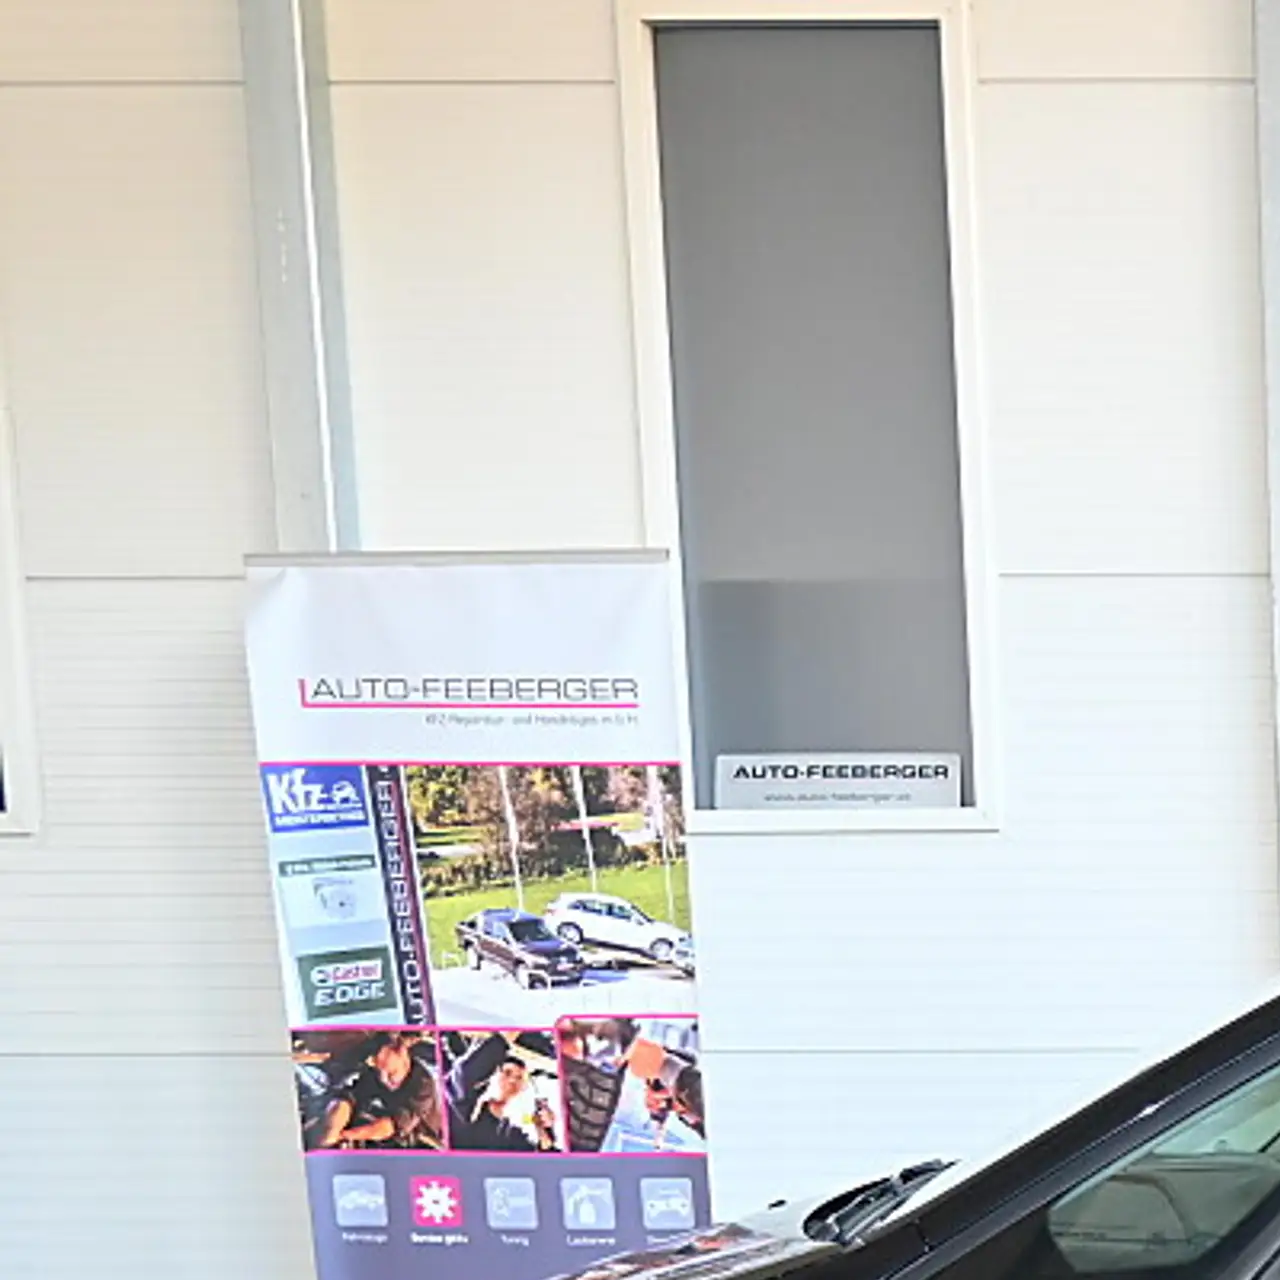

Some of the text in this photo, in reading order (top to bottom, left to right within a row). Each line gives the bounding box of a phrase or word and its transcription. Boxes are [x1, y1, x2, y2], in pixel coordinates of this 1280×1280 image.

[312, 678, 639, 700] AUTO-FEEBERGER
[733, 764, 949, 779] AUTO-FEEBERGER
[314, 981, 386, 1006] EDGE
